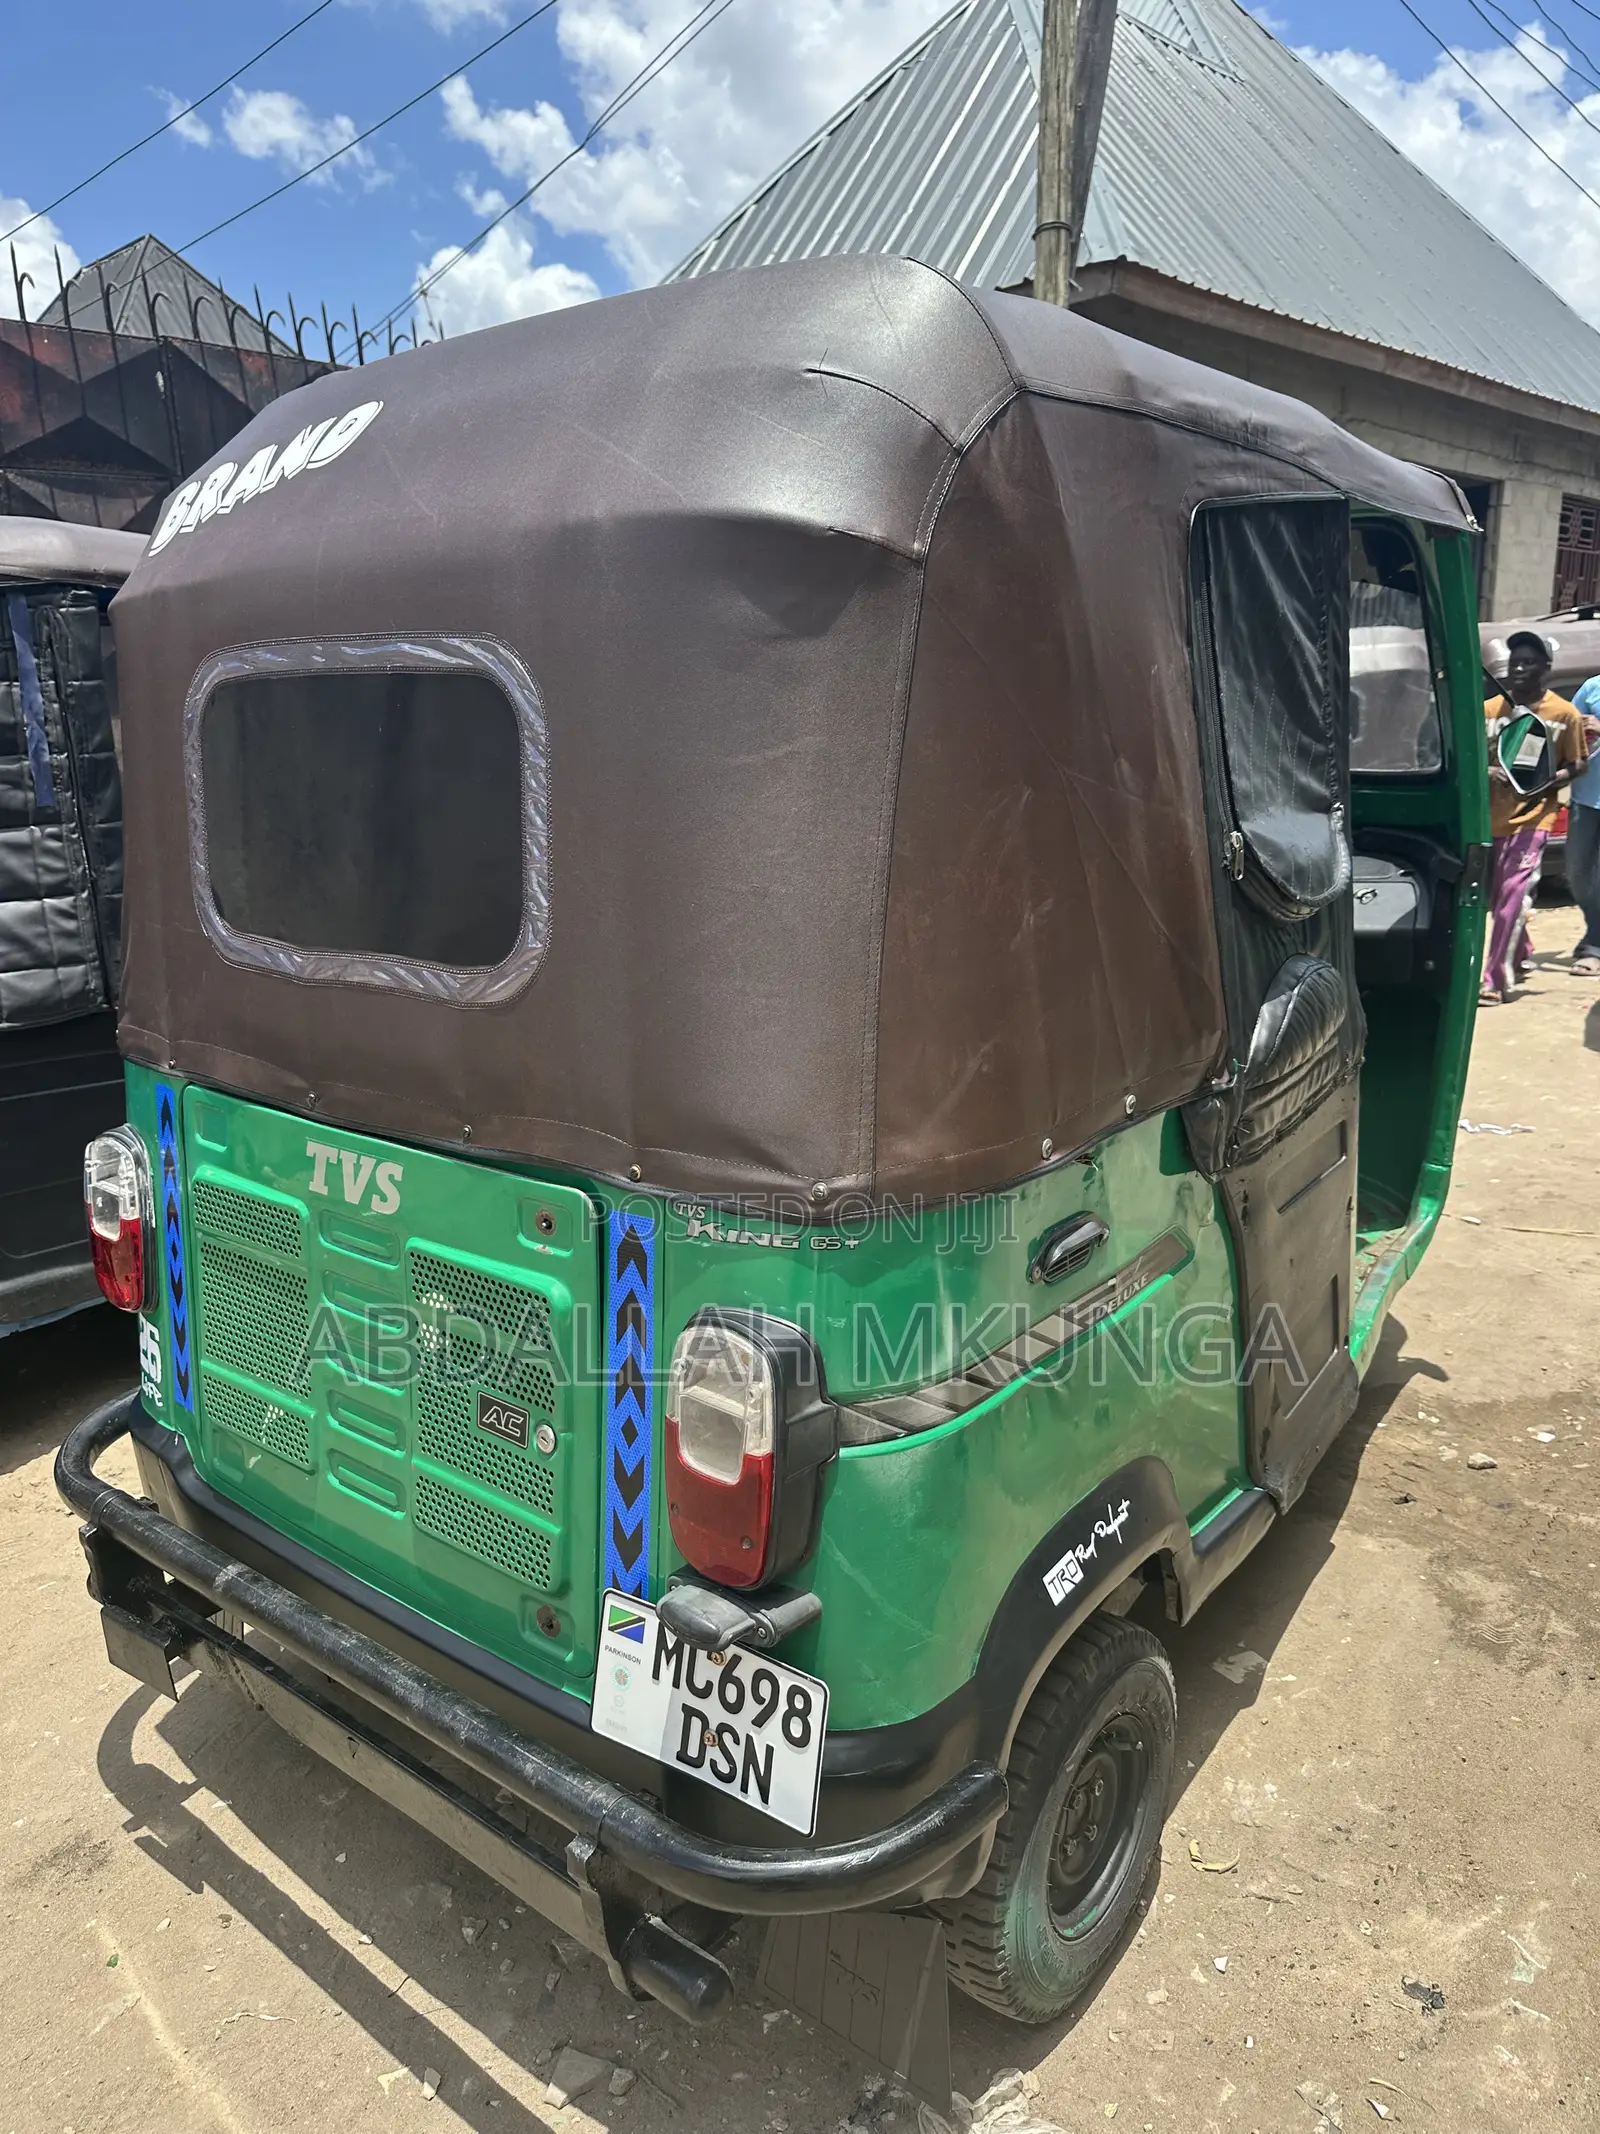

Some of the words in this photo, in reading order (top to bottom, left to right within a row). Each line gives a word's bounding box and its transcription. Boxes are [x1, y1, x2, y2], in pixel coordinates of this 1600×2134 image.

[306, 1140, 404, 1215] TVS
[676, 1202, 706, 1219] TVS
[687, 1219, 800, 1249] KING
[1095, 1272, 1149, 1320] DELUXE
[482, 1405, 525, 1438] AC
[604, 1644, 642, 1665] PARKINSON
[675, 1702, 775, 1806] DSN
